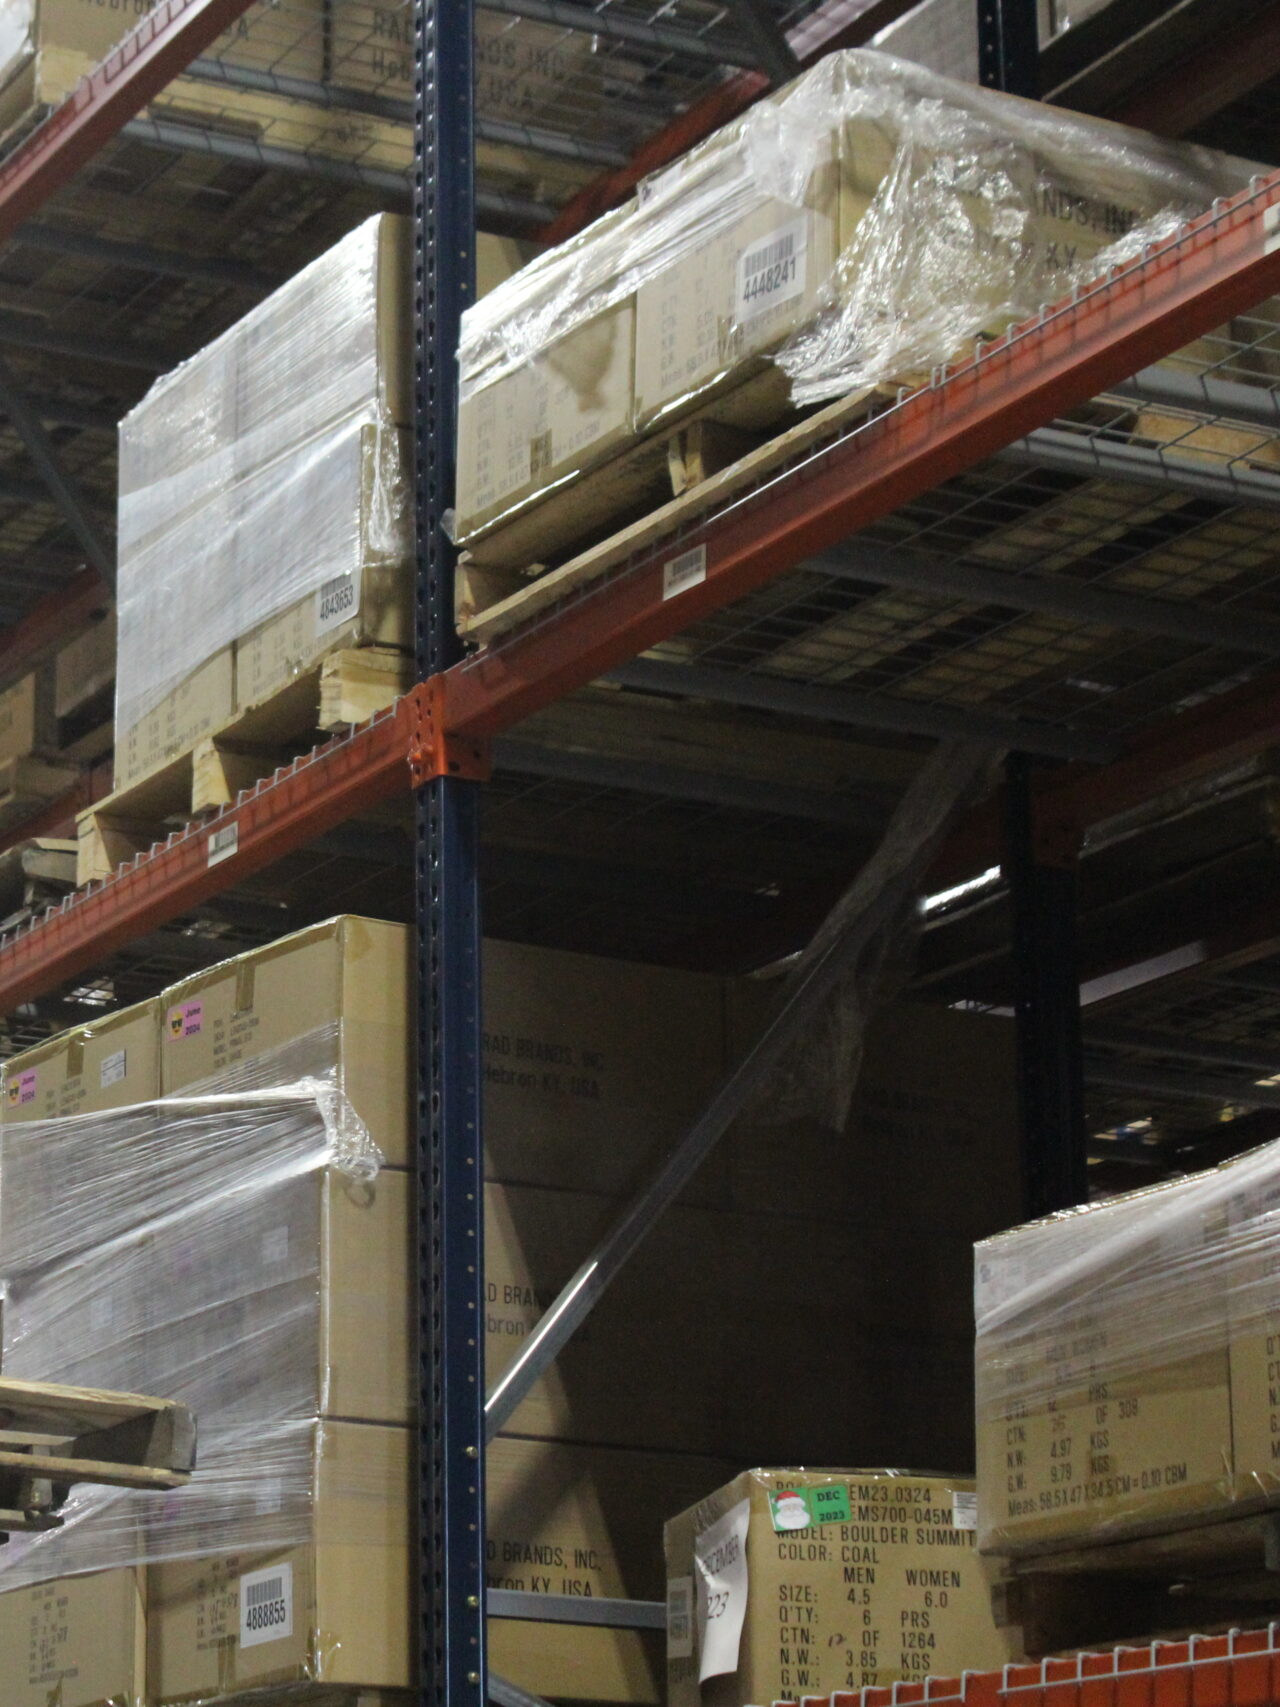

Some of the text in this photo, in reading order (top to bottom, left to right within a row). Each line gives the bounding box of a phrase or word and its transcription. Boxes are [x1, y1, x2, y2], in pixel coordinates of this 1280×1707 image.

[743, 257, 797, 302] 4448241
[320, 584, 353, 621] 4843653
[1096, 1405, 1109, 1425] OF
[1090, 1429, 1110, 1451] KGS
[1165, 1462, 1188, 1485] CBM
[817, 1490, 841, 1503] DEC
[819, 1511, 846, 1523] 2023
[841, 1525, 909, 1545] BOULDER
[916, 1527, 977, 1547] SUMMIT
[503, 1542, 567, 1571] BRANDS,
[778, 1543, 880, 1565] COLOR: COAL
[532, 1576, 550, 1593] KY
[843, 1566, 961, 1588] MEN WOMEN
[779, 1585, 949, 1609] SIZE: 4.5 6.0
[246, 1599, 286, 1631] 4888855
[779, 1606, 930, 1629] Q'TY: 6 PRS
[780, 1628, 816, 1645] CTN:
[862, 1630, 880, 1646] OF
[901, 1632, 936, 1650] 1264
[780, 1649, 930, 1671] N.W.: 3.85 KGS
[781, 1669, 820, 1687] G.W.:
